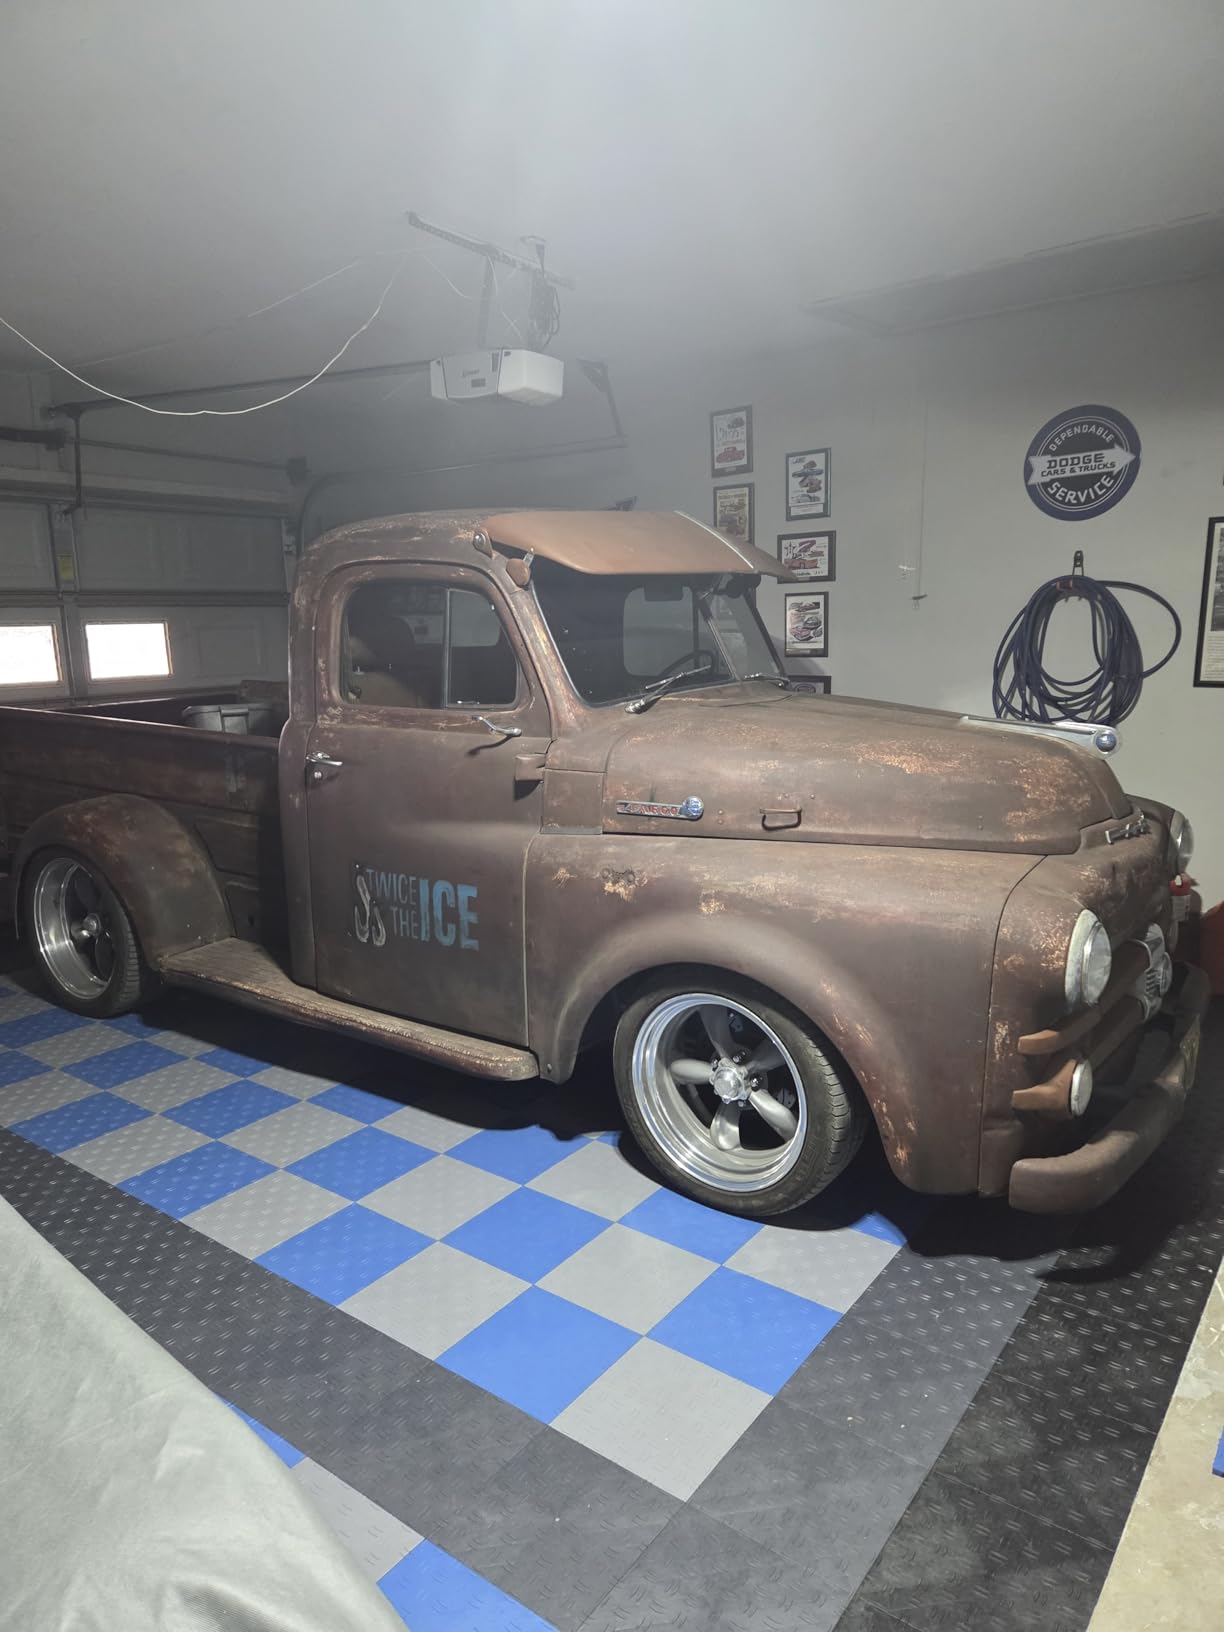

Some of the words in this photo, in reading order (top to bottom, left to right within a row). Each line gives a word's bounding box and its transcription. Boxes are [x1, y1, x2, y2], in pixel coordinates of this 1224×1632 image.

[1049, 424, 1115, 452] DEPENDABLE
[1040, 467, 1066, 478] CARS
[1069, 466, 1077, 474] &
[1078, 461, 1116, 473] TRUCKS
[1046, 453, 1105, 470] DODGE
[1047, 475, 1115, 504] SERVICE
[365, 868, 417, 905] TWICE
[390, 905, 419, 939] THE
[418, 876, 479, 952] ICE
